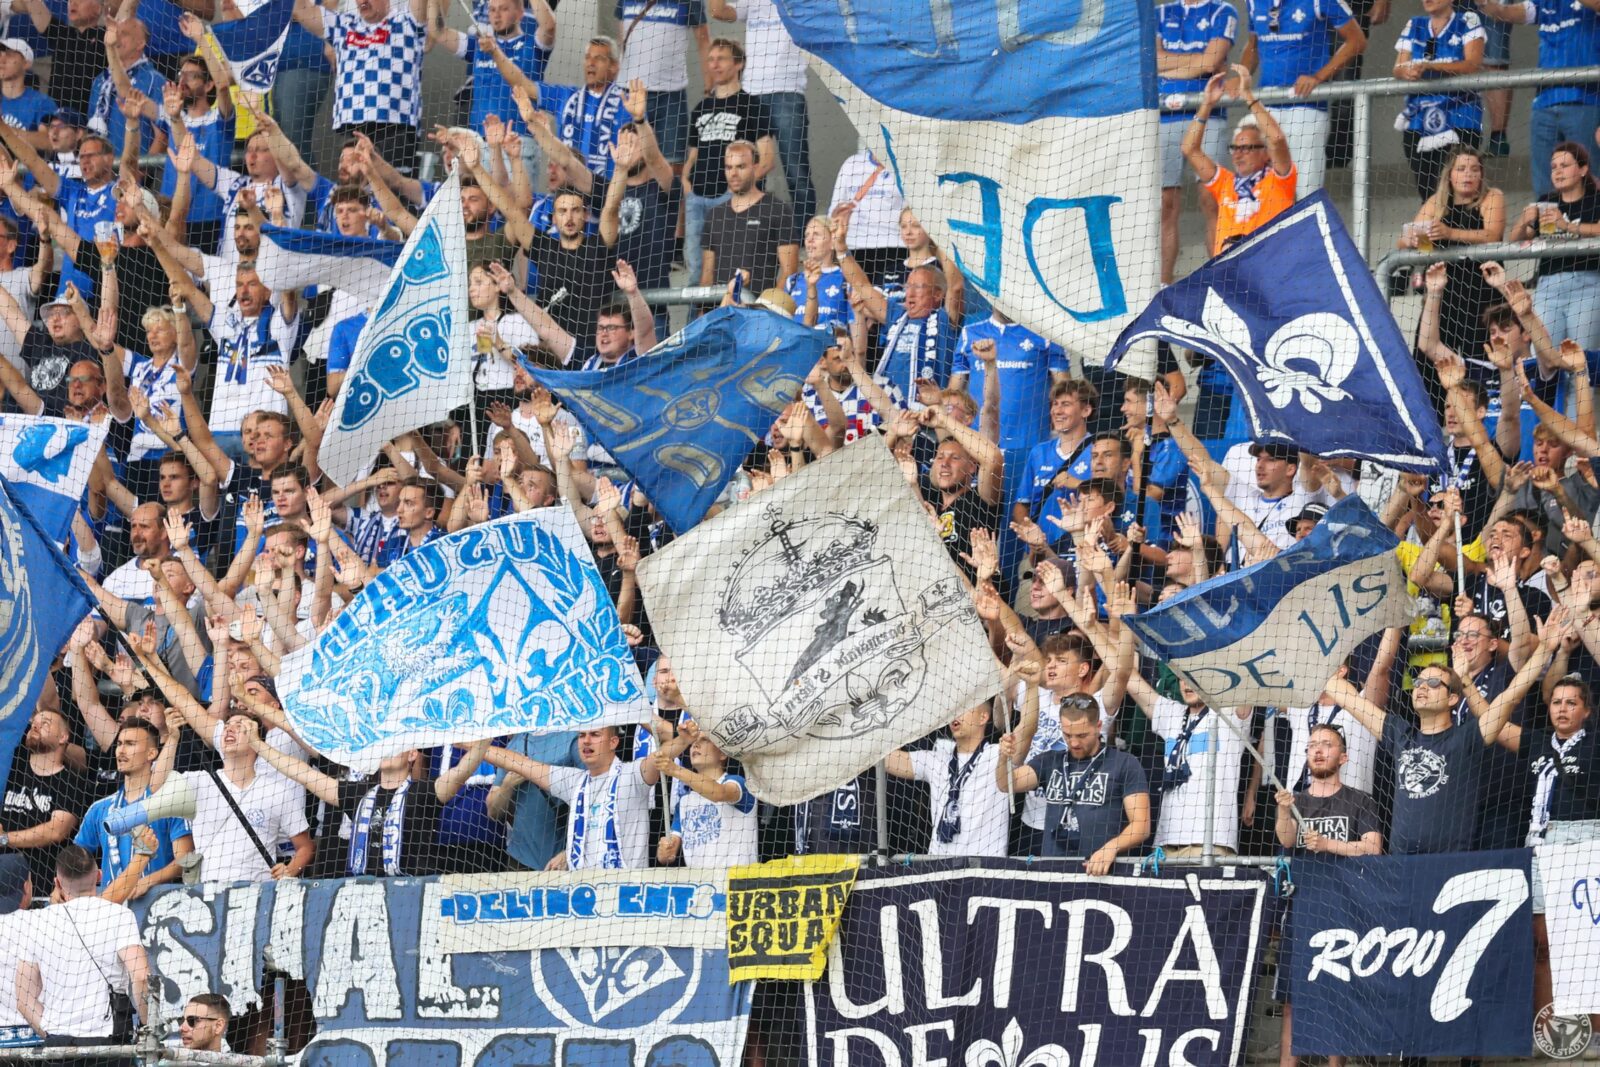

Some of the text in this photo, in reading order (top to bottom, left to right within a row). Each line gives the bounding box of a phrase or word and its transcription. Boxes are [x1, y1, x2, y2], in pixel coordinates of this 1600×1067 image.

[1181, 570, 1388, 696] DE LIS
[1080, 788, 1104, 803] LIS
[729, 882, 853, 921] URBAN
[729, 918, 825, 955] SQUA
[1308, 867, 1530, 1023] ROW 7
